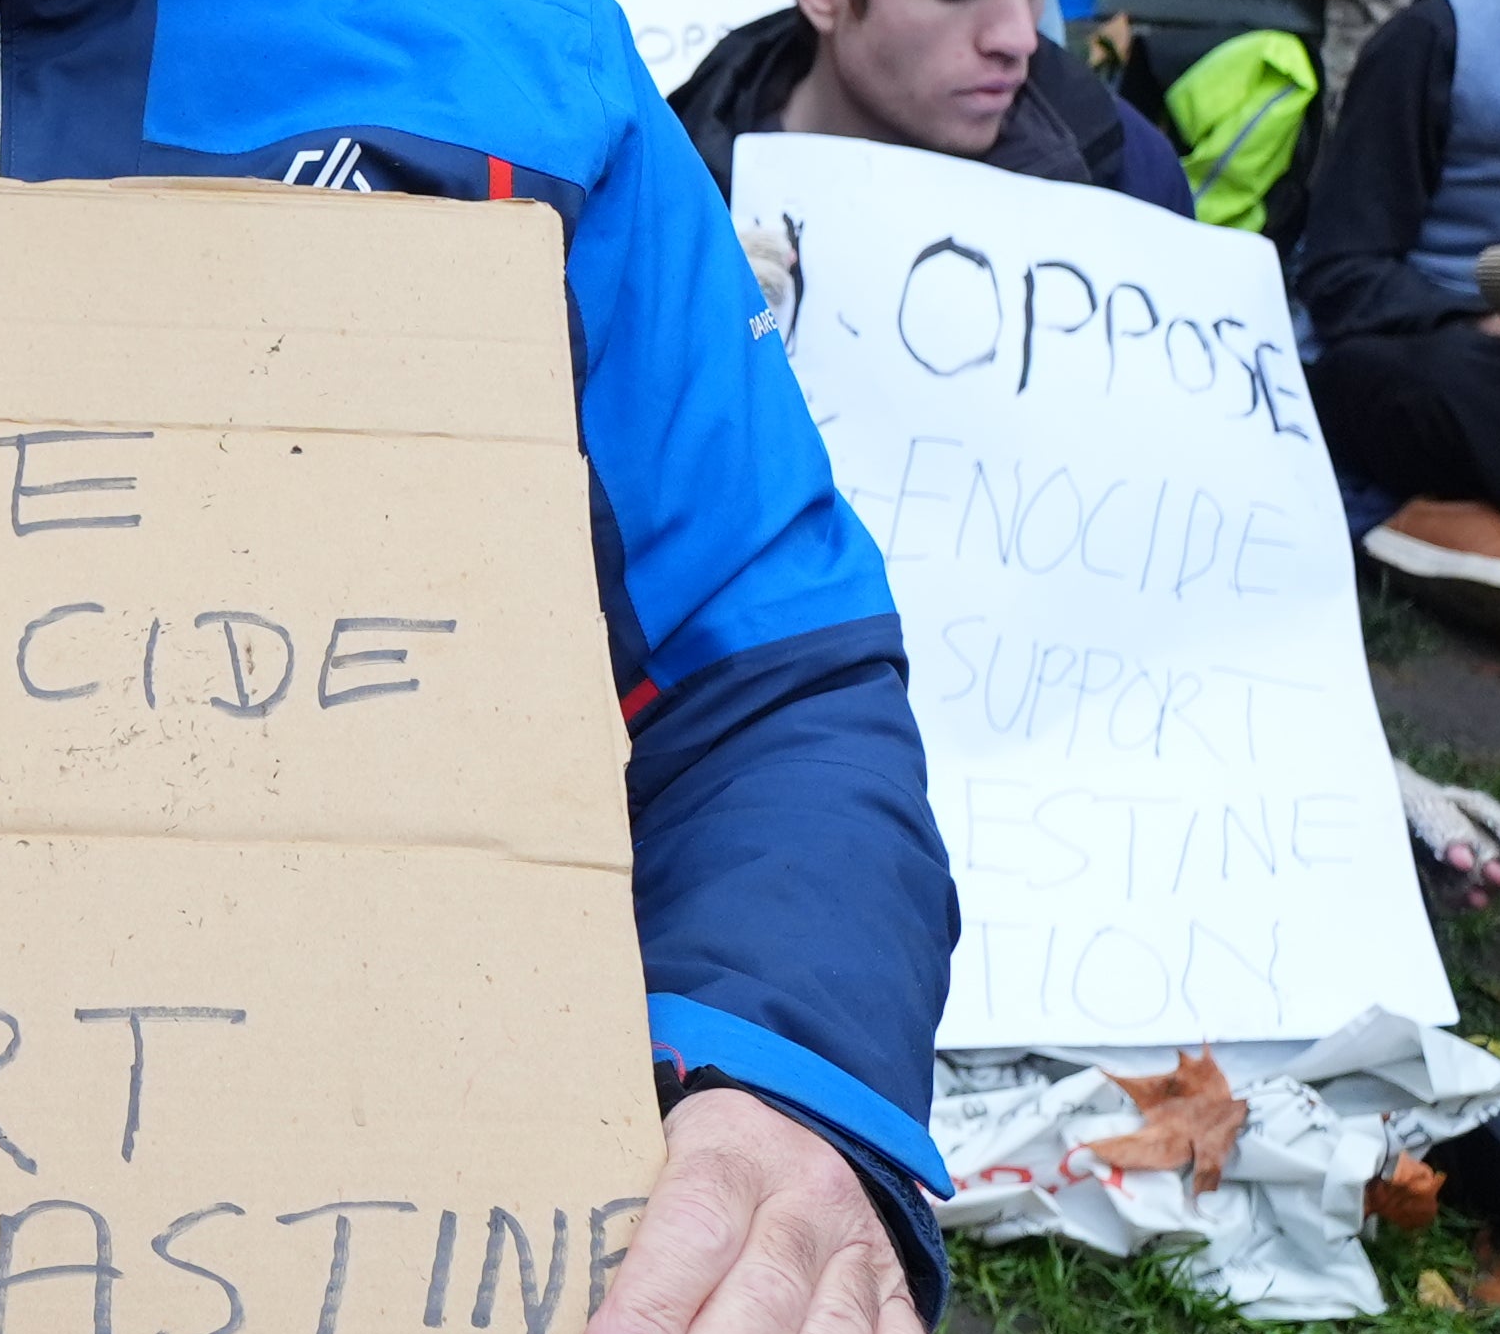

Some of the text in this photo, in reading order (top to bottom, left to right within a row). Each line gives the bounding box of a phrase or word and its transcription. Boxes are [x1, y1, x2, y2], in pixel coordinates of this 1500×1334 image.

[898, 236, 1310, 443] OPPOSE
[836, 435, 1297, 601] ENOCIDE
[940, 616, 1326, 766] SUPPORT
[964, 775, 1362, 902] ESTINE
[960, 915, 1284, 1029] TION
